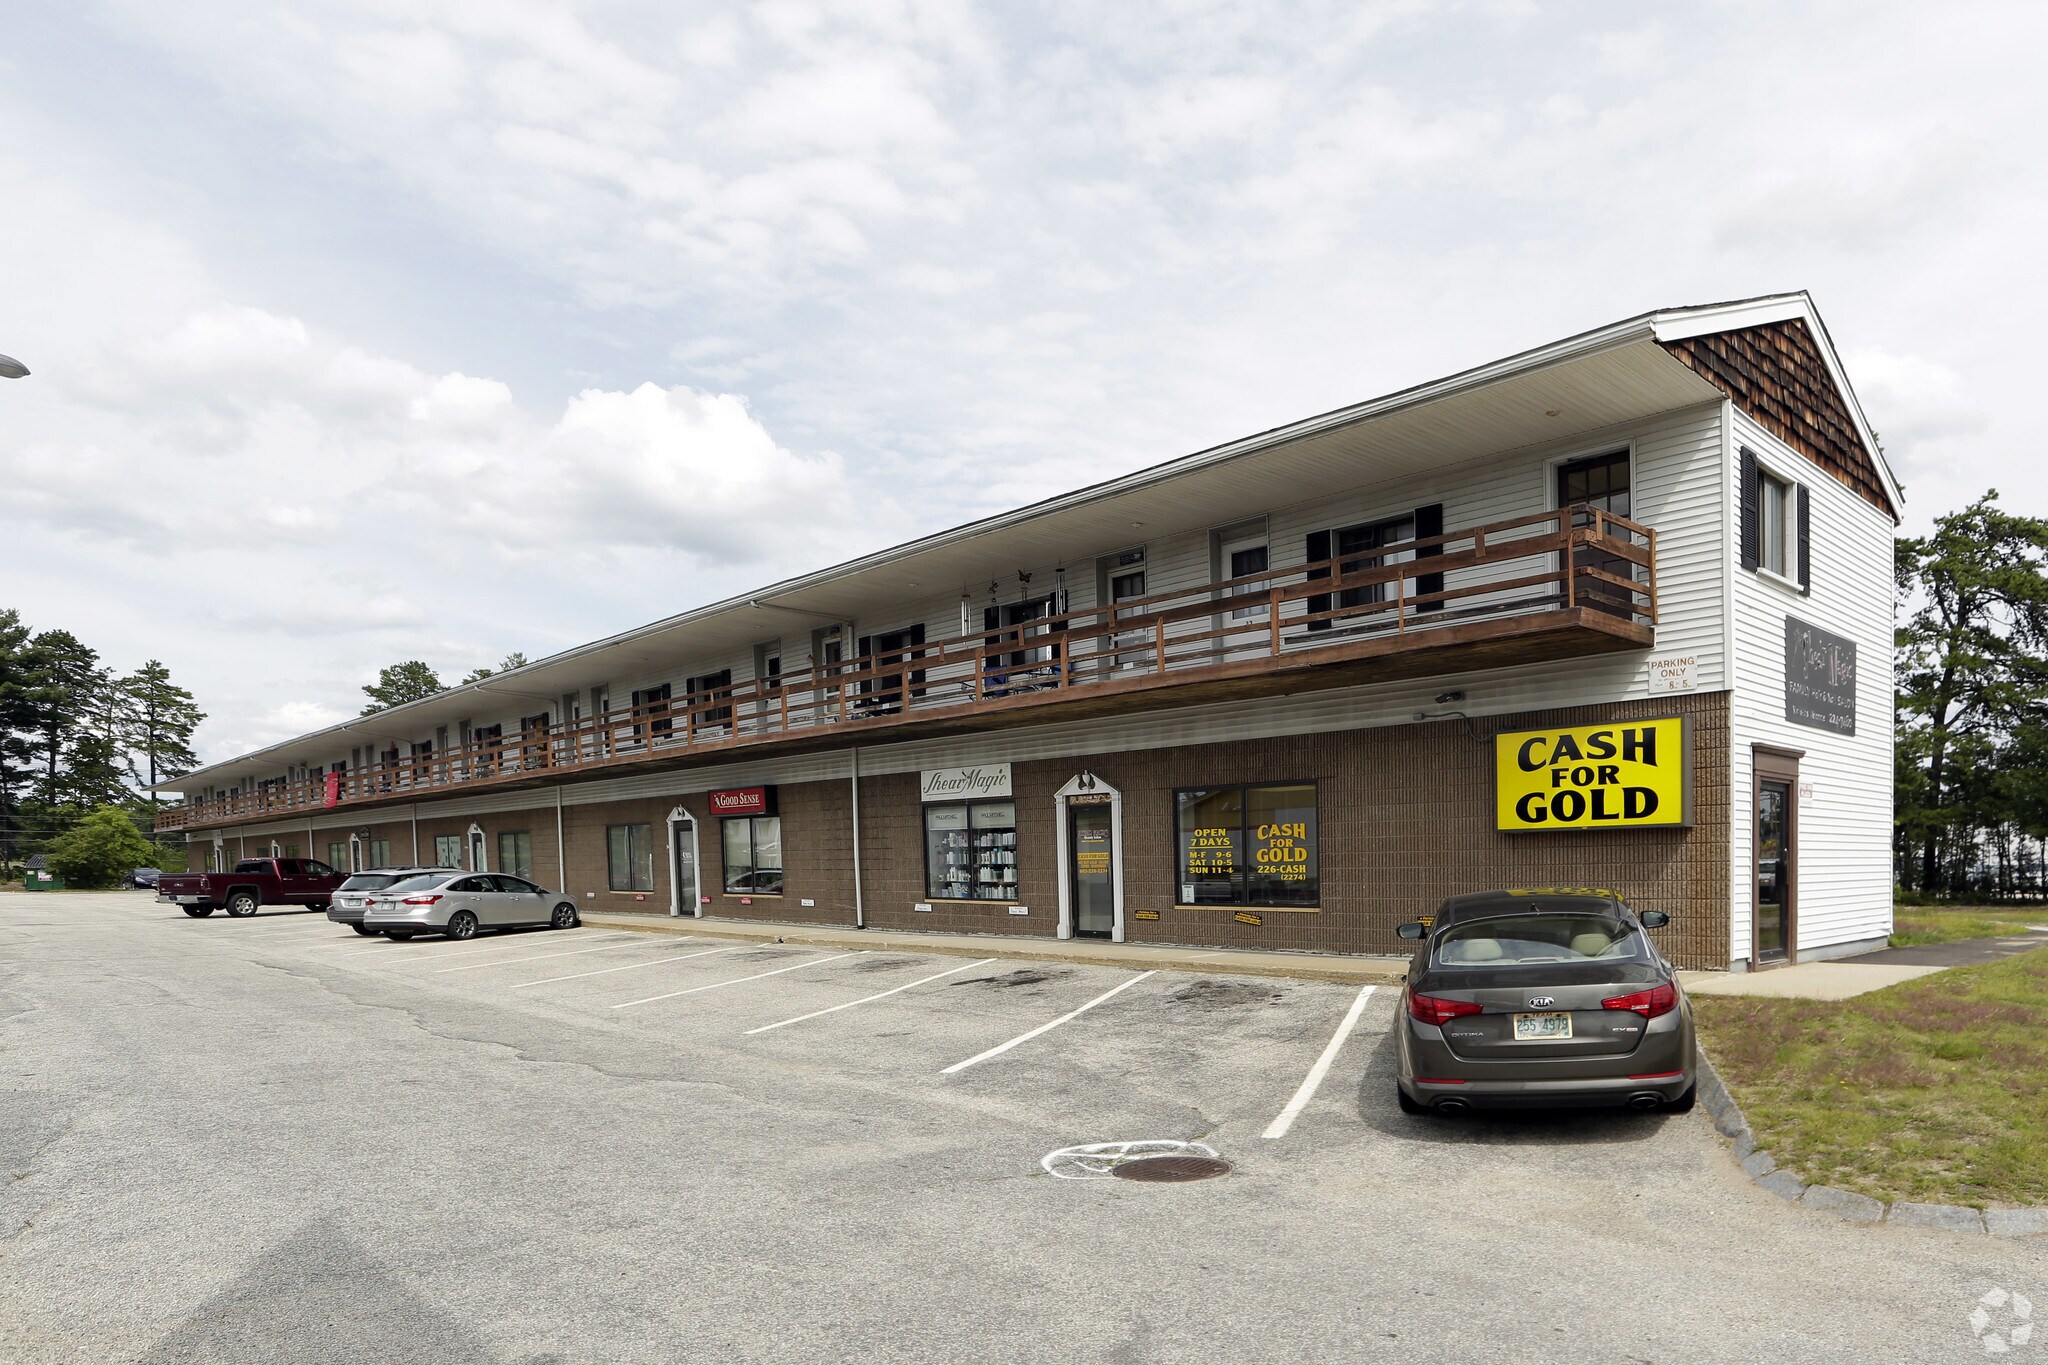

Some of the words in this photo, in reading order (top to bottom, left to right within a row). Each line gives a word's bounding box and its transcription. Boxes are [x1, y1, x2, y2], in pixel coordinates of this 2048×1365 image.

[1651, 656, 1695, 669] PARKING
[1660, 668, 1686, 678] ONLY
[1682, 679, 1688, 688] 5
[1517, 727, 1658, 772] CASH
[923, 772, 965, 794] Shear
[965, 768, 1007, 793] Magic
[1551, 765, 1620, 788] FOR
[720, 794, 739, 806] GOOD
[739, 792, 760, 804] SENSE
[1515, 786, 1659, 823] GOLD
[1194, 828, 1226, 837] OPEN
[1257, 823, 1306, 840] CASH
[1191, 838, 1197, 846] 7
[1199, 837, 1231, 846] DAYS
[1270, 839, 1294, 848] FOR
[1256, 847, 1308, 863] GOLD
[1257, 864, 1306, 874] 226-CASH
[1517, 1018, 1536, 1032] 255
